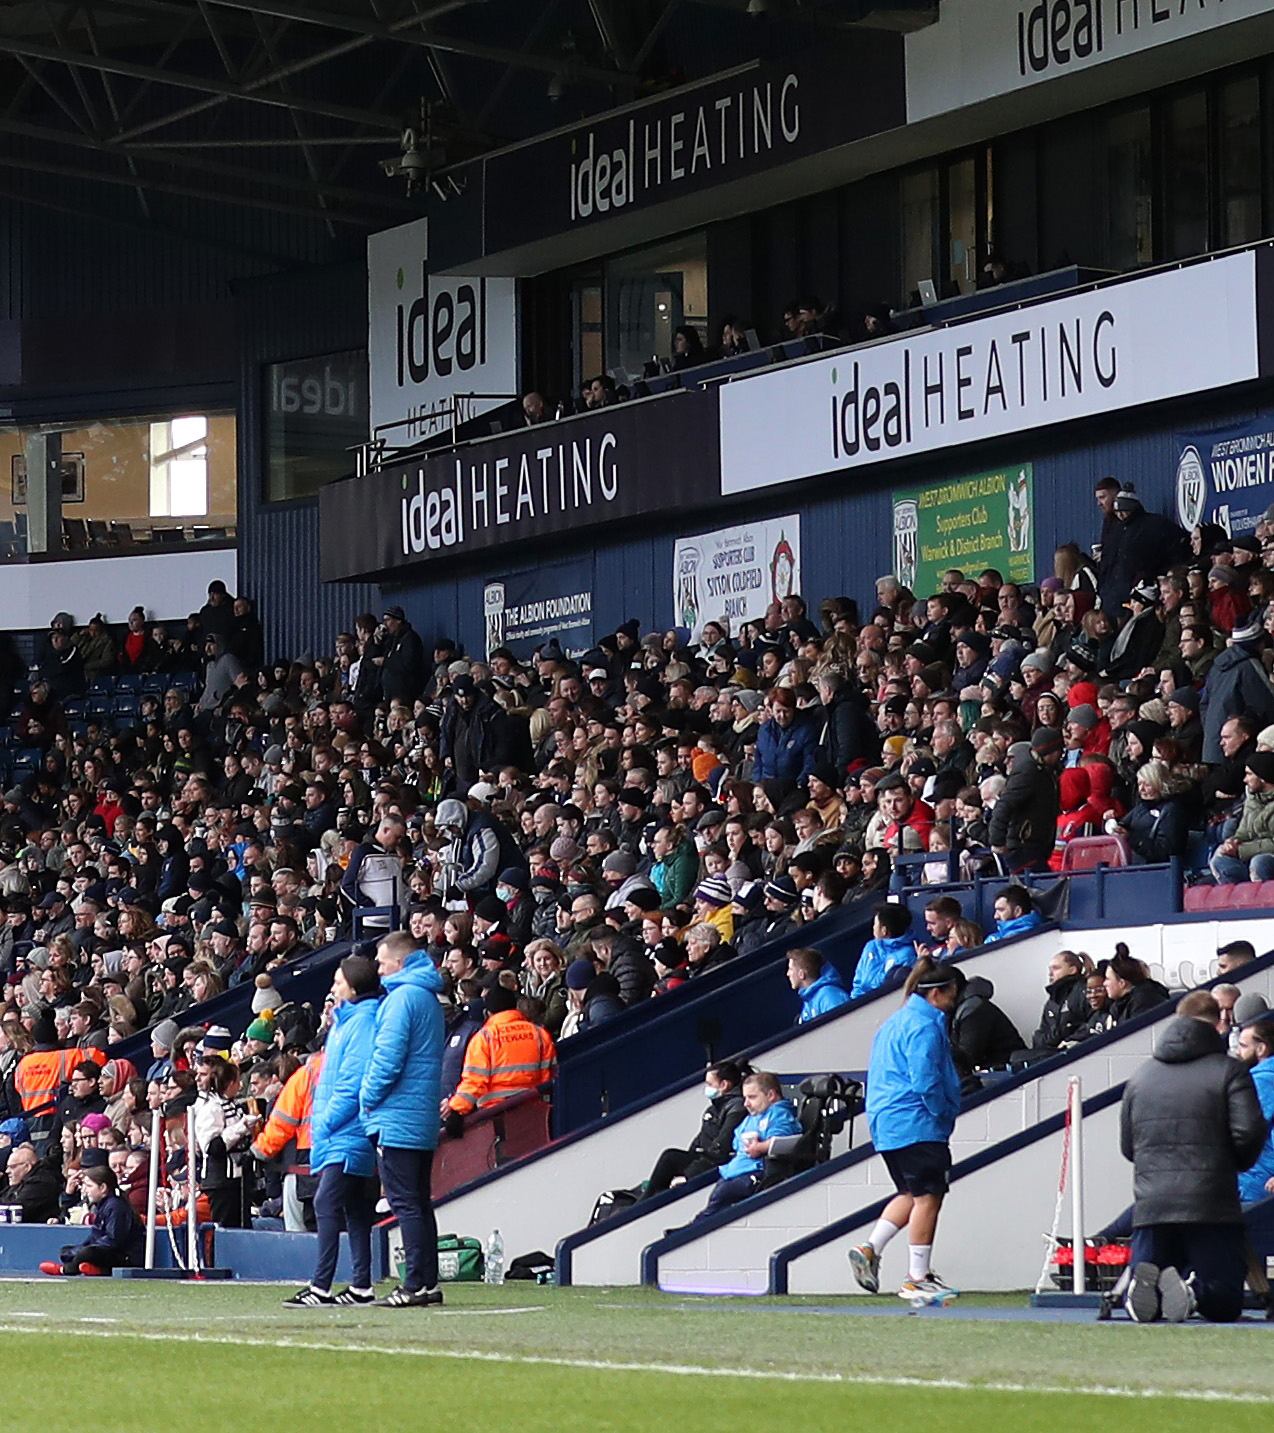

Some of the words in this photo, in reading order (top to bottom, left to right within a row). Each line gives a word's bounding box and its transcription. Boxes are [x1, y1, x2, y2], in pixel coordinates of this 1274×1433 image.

[570, 120, 636, 221] ideal
[644, 74, 800, 188] HEATING
[397, 259, 486, 386] ideal
[831, 348, 912, 459] ideal
[922, 310, 1118, 428] HEATING
[407, 392, 477, 438] HEATING
[401, 462, 464, 555] ideal
[470, 432, 618, 530] HEATING
[1211, 453, 1266, 493] WOMEN
[936, 510, 971, 536] Supporters
[972, 505, 989, 526] Club
[921, 539, 950, 562] Warwick
[957, 534, 980, 556] District
[980, 529, 1004, 551] Branch
[504, 606, 519, 627] THE
[519, 600, 545, 625] ALBION
[545, 591, 591, 619] FOUNDATION
